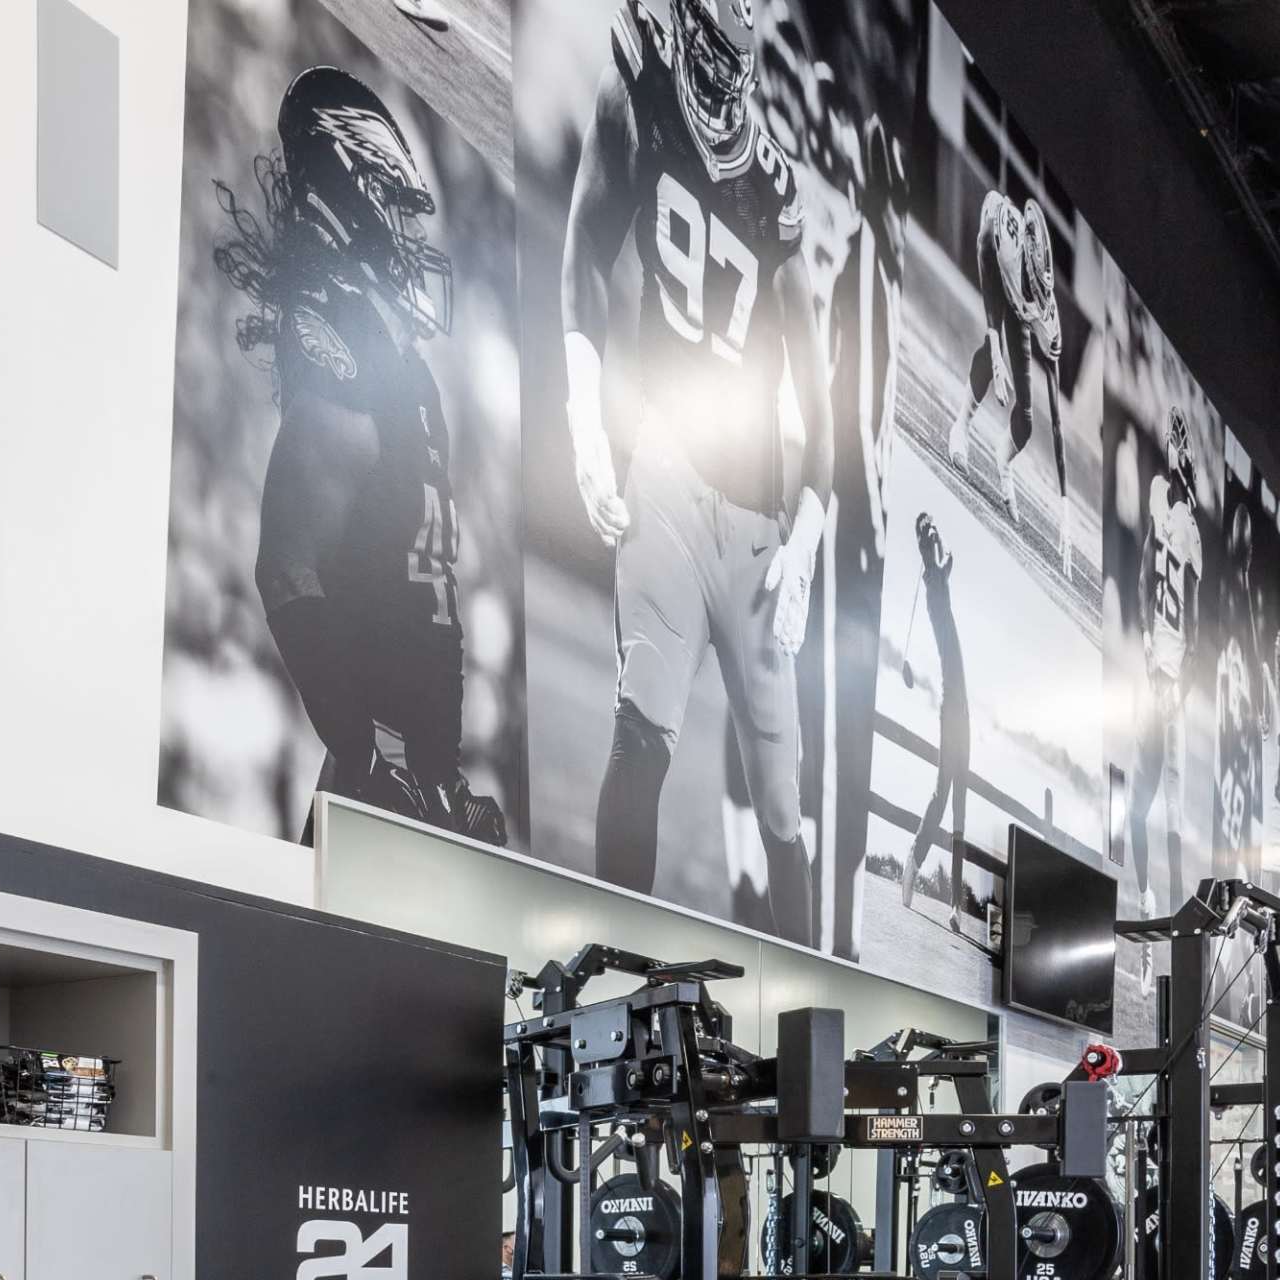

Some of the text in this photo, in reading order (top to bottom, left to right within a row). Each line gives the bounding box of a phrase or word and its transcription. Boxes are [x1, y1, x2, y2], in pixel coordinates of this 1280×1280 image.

[655, 172, 759, 368] 97
[873, 1118, 917, 1128] HAMMER
[871, 1128, 919, 1138] STRENGTH
[298, 1185, 408, 1214] HERBALIFE
[1016, 1190, 1088, 1209] IVANKO
[1240, 1217, 1259, 1270] IVANKO
[1036, 1263, 1055, 1276] 25
